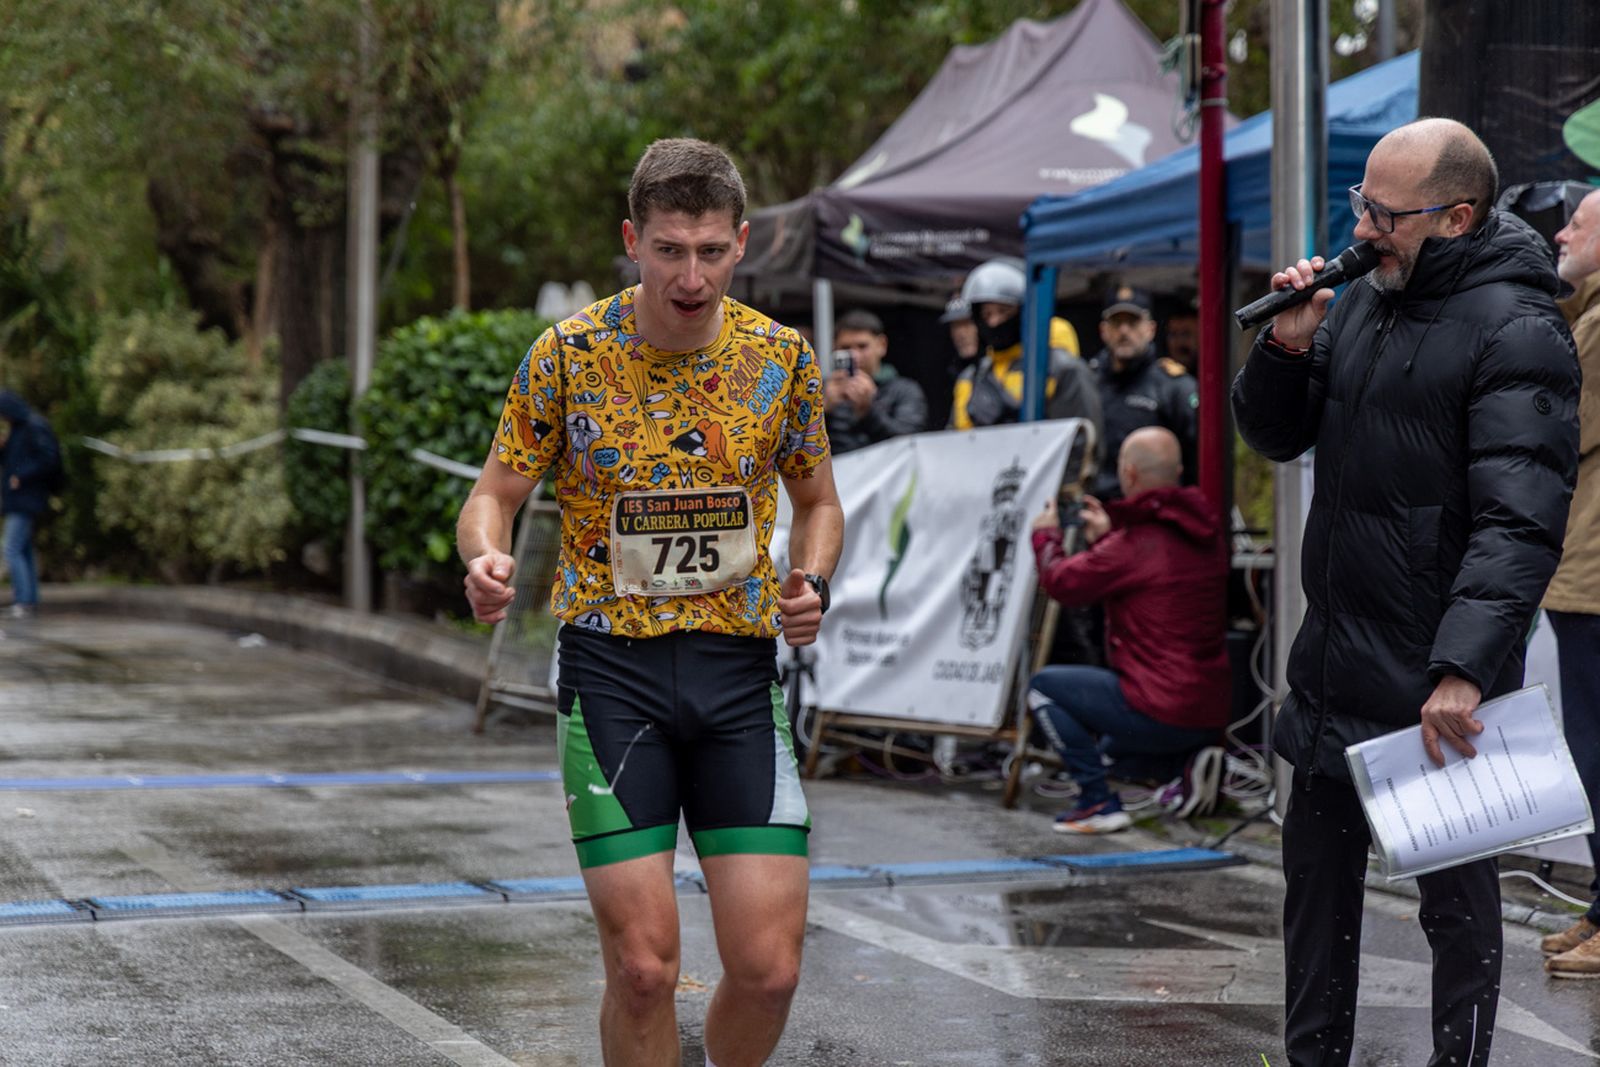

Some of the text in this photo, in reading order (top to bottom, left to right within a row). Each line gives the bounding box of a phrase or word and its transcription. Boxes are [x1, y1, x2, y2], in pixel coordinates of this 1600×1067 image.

[624, 495, 740, 513] IES San Juan Bosco
[621, 511, 744, 531] V CARRERA POPULAR
[651, 534, 720, 575] 725
